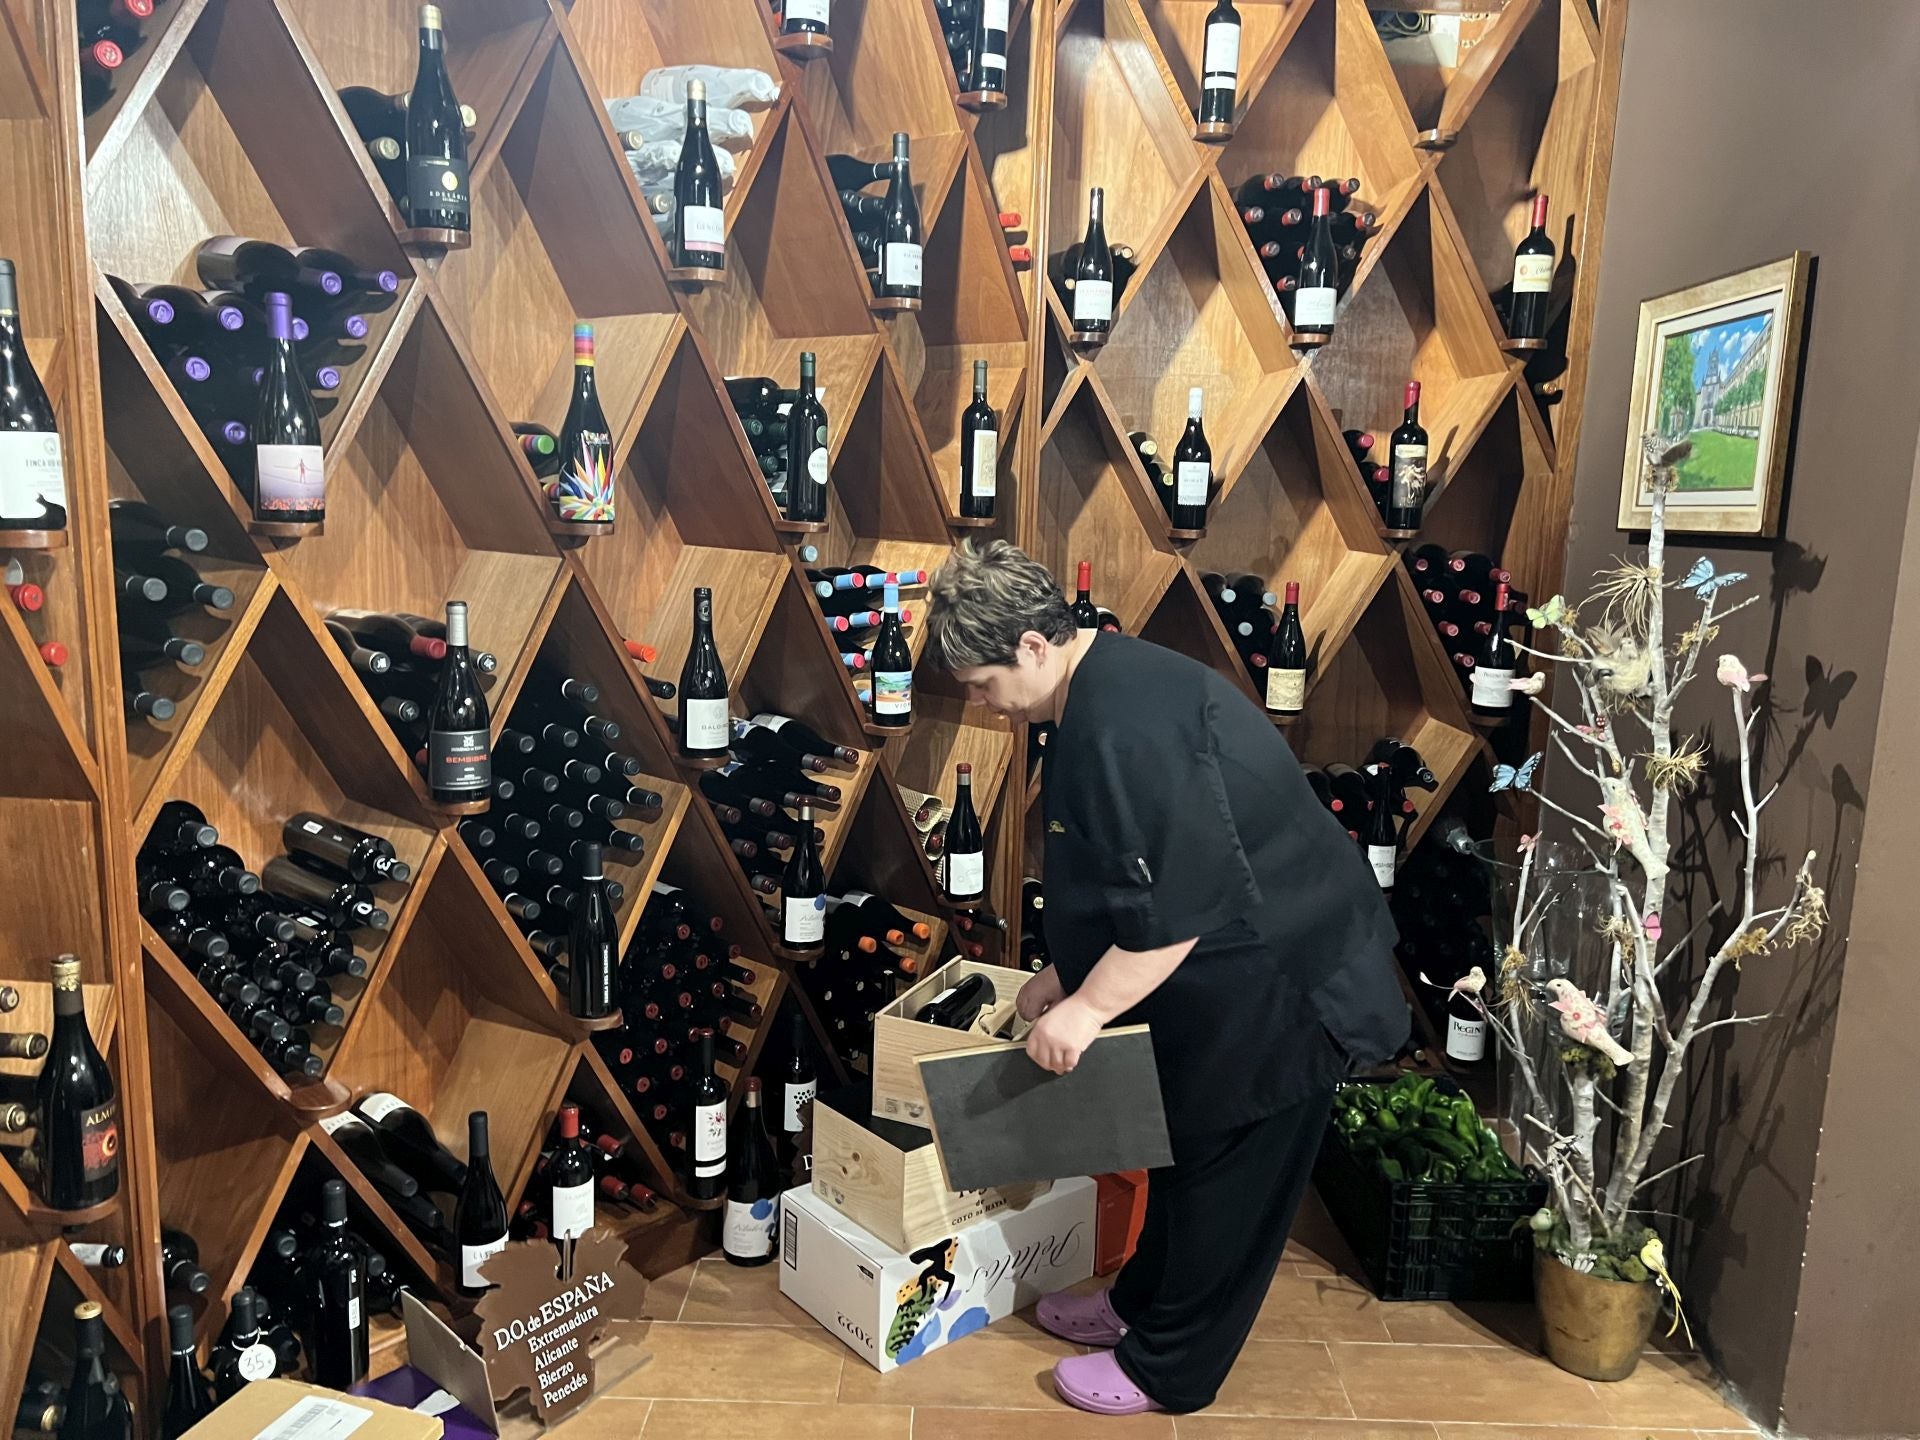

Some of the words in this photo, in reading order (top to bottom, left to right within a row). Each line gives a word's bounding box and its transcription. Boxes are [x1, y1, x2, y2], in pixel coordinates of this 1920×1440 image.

[951, 1212, 974, 1226] COTO
[493, 1319, 528, 1351] D.O.
[527, 1315, 542, 1333] de
[538, 1271, 615, 1325] ESPAÑA
[527, 1305, 600, 1354] Extremadura
[836, 1311, 874, 1350] 2022
[534, 1336, 580, 1372] Alicante
[537, 1360, 575, 1390] Bierzo
[542, 1371, 589, 1409] Penedés
